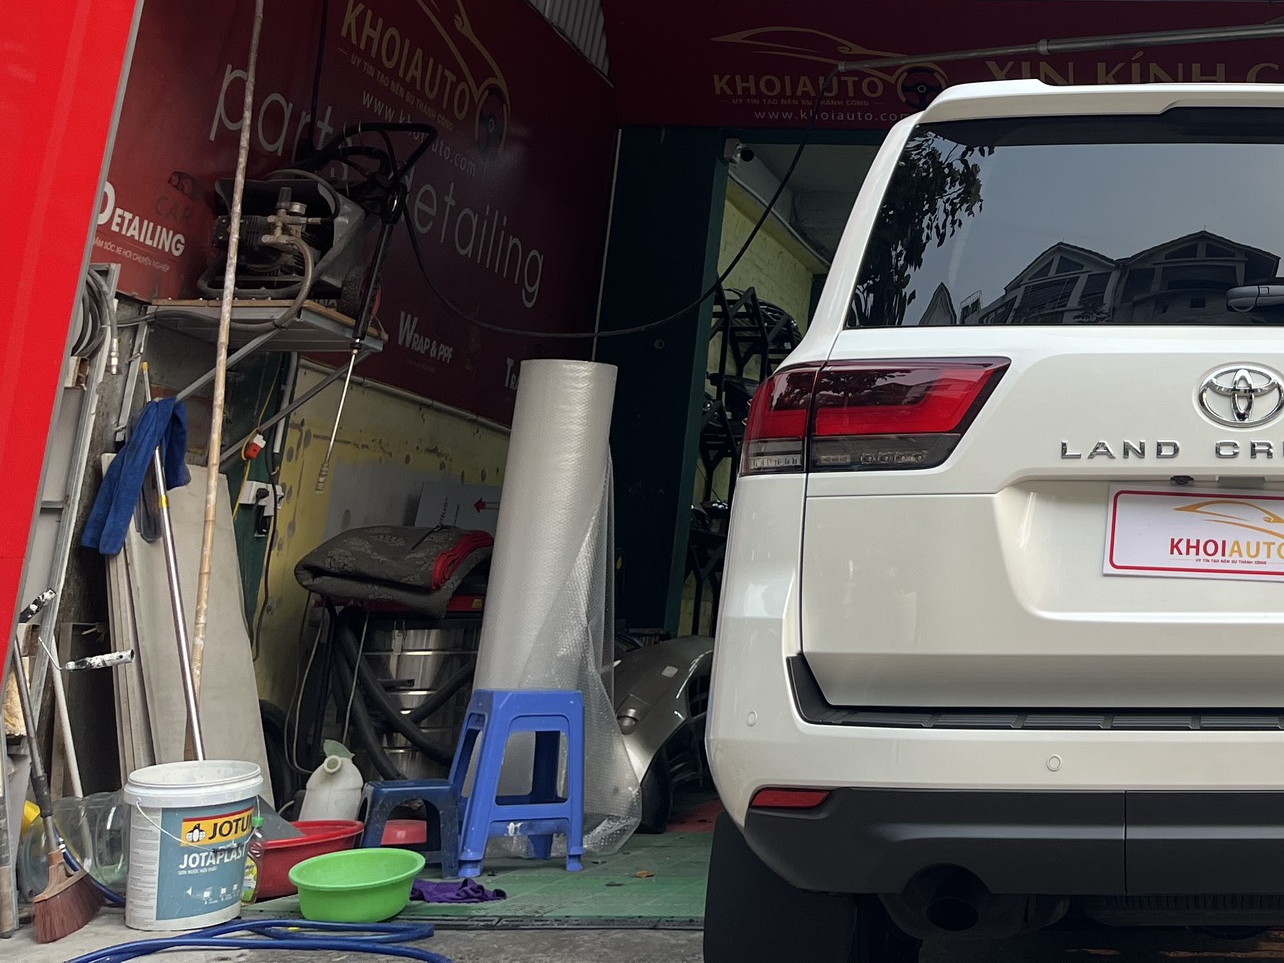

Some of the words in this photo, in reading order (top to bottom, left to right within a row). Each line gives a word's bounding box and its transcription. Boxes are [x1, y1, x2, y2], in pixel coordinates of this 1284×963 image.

[1097, 50, 1226, 85] KÍNH
[713, 73, 884, 98] KHOIAUTO
[1060, 440, 1181, 460] LAND
